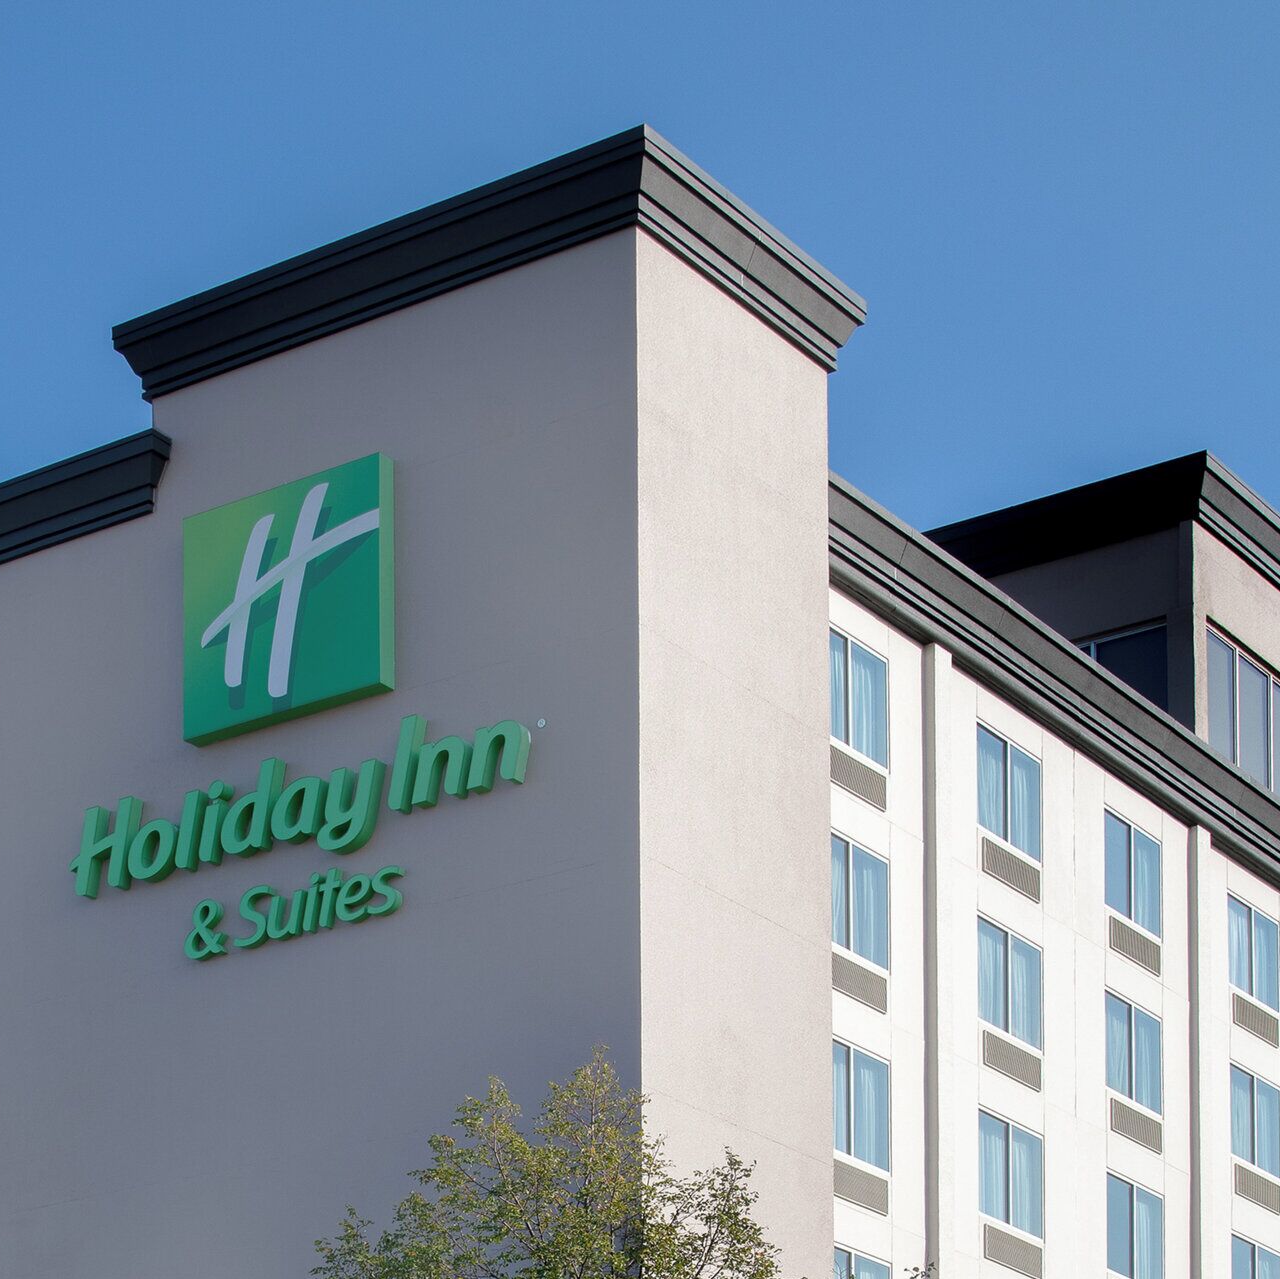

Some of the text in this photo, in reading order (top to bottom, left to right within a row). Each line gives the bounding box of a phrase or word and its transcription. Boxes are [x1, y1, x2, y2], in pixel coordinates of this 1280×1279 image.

[70, 713, 532, 899] Holiday Inn
[184, 865, 406, 961] & Suites
